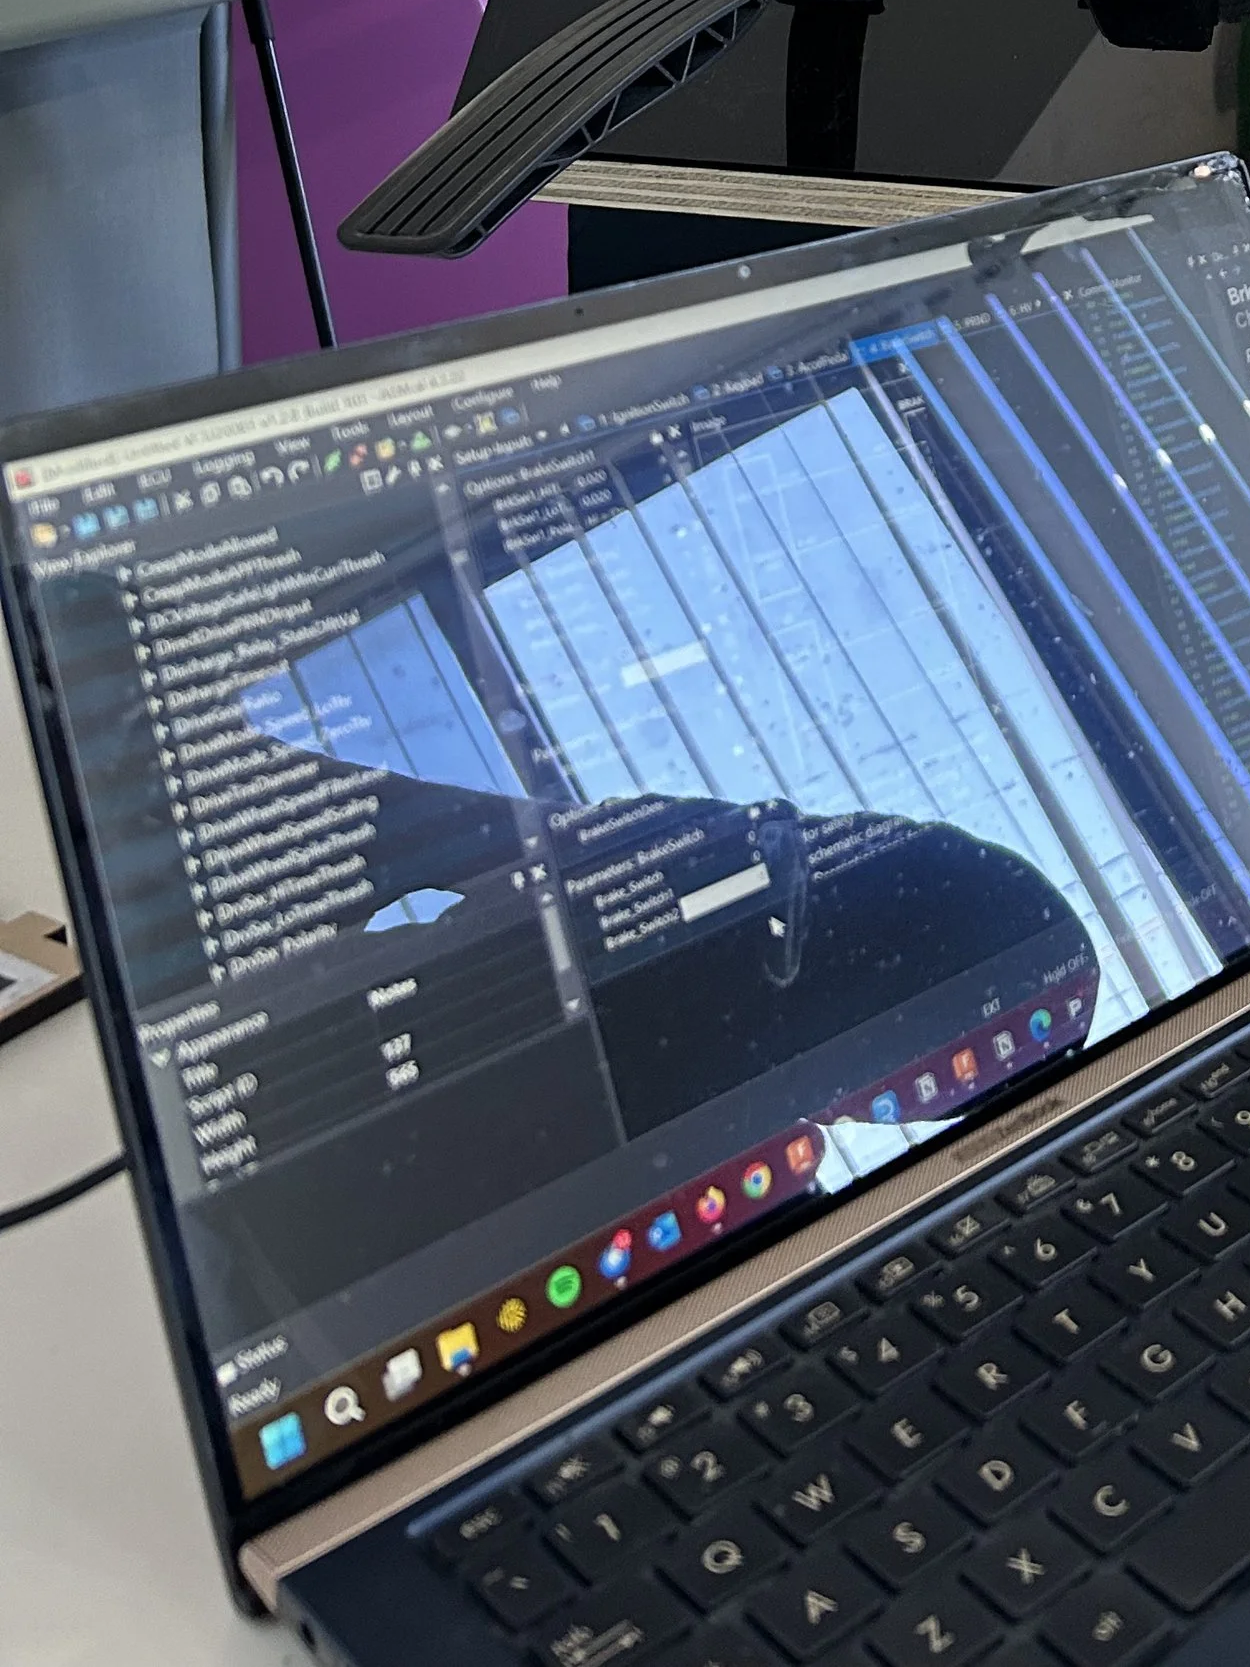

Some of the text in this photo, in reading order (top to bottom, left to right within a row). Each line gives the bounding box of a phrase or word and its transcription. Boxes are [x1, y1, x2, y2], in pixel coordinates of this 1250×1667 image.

[193, 450, 256, 476] Logging
[274, 435, 311, 457] View
[387, 404, 435, 428] Layout
[453, 384, 515, 411] Configure
[636, 828, 706, 868] BrakeSwitch
[808, 833, 866, 865] schematic
[595, 870, 664, 909] Brake_Switch
[601, 887, 674, 931] Brake_Switch1
[604, 908, 681, 950] Brake_Switch2
[982, 996, 1001, 1018] EXT
[1170, 1151, 1197, 1172] 8
[1101, 1192, 1122, 1216] 7
[1197, 1211, 1229, 1237] U
[1035, 1237, 1057, 1262] 6
[1127, 1257, 1155, 1283] Y
[953, 1284, 981, 1312] 5
[1214, 1291, 1249, 1322] H
[1052, 1308, 1081, 1335] T
[877, 1337, 900, 1363] 4
[1140, 1343, 1176, 1373] G
[976, 1362, 1009, 1391] R
[784, 1393, 814, 1422] 3
[1063, 1399, 1090, 1431] F
[890, 1417, 924, 1449] E
[1170, 1421, 1202, 1452] V
[690, 1449, 726, 1483] 2
[977, 1459, 1015, 1492] D
[791, 1473, 836, 1512] W
[1093, 1484, 1130, 1517] C
[892, 1521, 928, 1554] S
[702, 1538, 744, 1575] Q
[1007, 1548, 1046, 1584] X
[804, 1589, 841, 1625] A
[915, 1614, 954, 1654] Z
